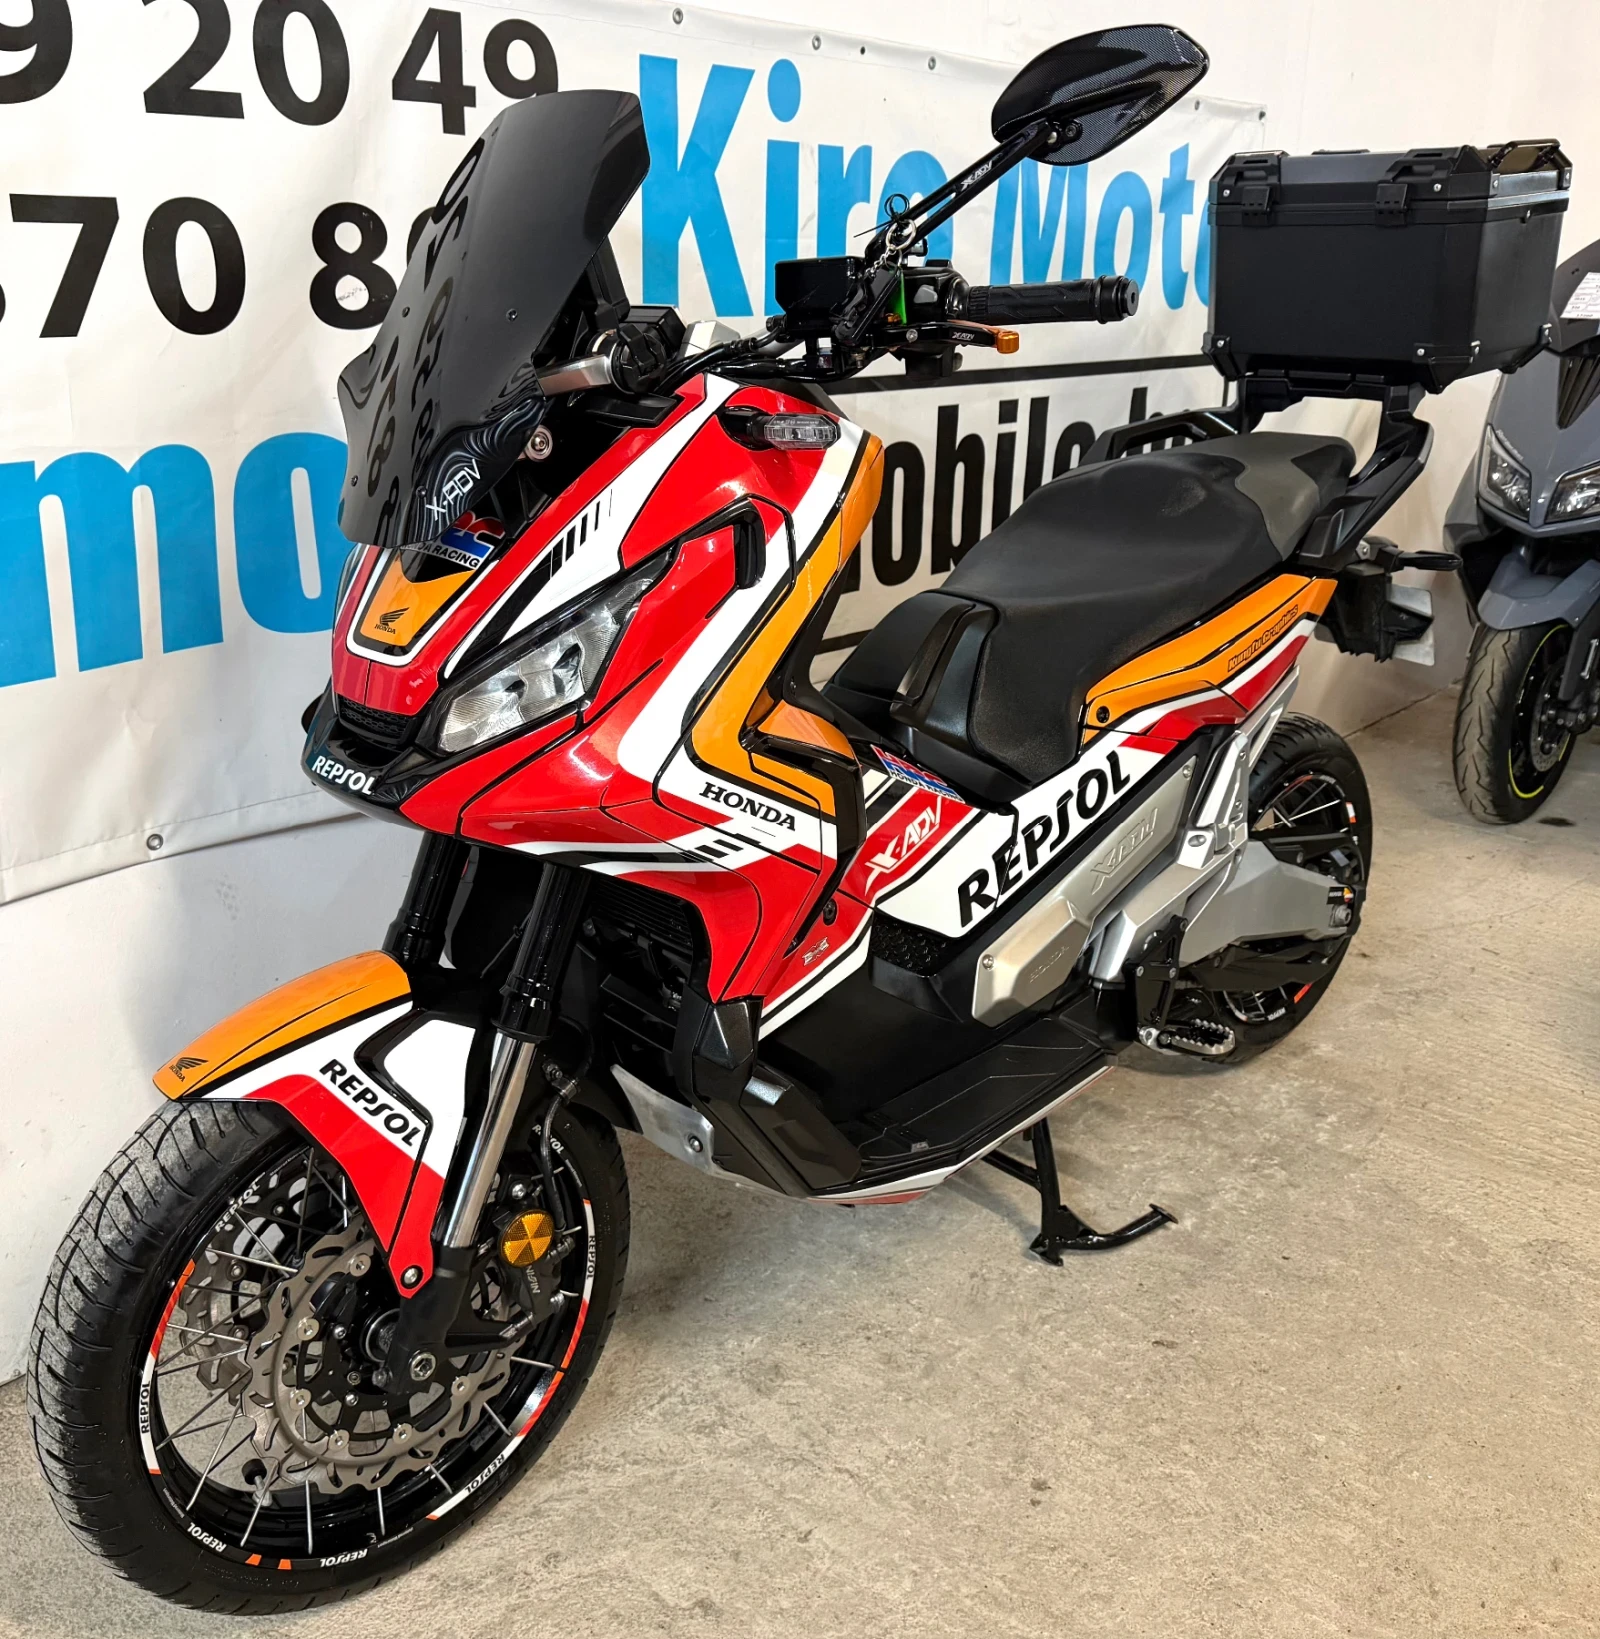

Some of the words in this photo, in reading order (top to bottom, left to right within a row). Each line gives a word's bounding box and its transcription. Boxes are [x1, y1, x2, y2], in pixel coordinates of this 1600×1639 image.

[143, 0, 350, 126] 20
[392, 7, 558, 136] 49
[639, 54, 954, 318] Kiro
[0, 193, 246, 339] 70
[433, 544, 481, 568] RACING
[374, 623, 396, 635] HONDA
[312, 755, 376, 796] REPSOL
[699, 781, 796, 832] HONDA
[957, 750, 1131, 928] REPSOL
[169, 1064, 186, 1083] HONDA
[319, 1058, 421, 1147] REPSOL
[214, 1177, 261, 1233] REPSOL
[587, 1235, 596, 1280] REPSOL
[140, 1380, 150, 1435] REPSOL
[464, 1453, 505, 1494] REPSOL
[187, 1522, 227, 1553] REPSOL
[319, 1548, 368, 1569] REPSOL
